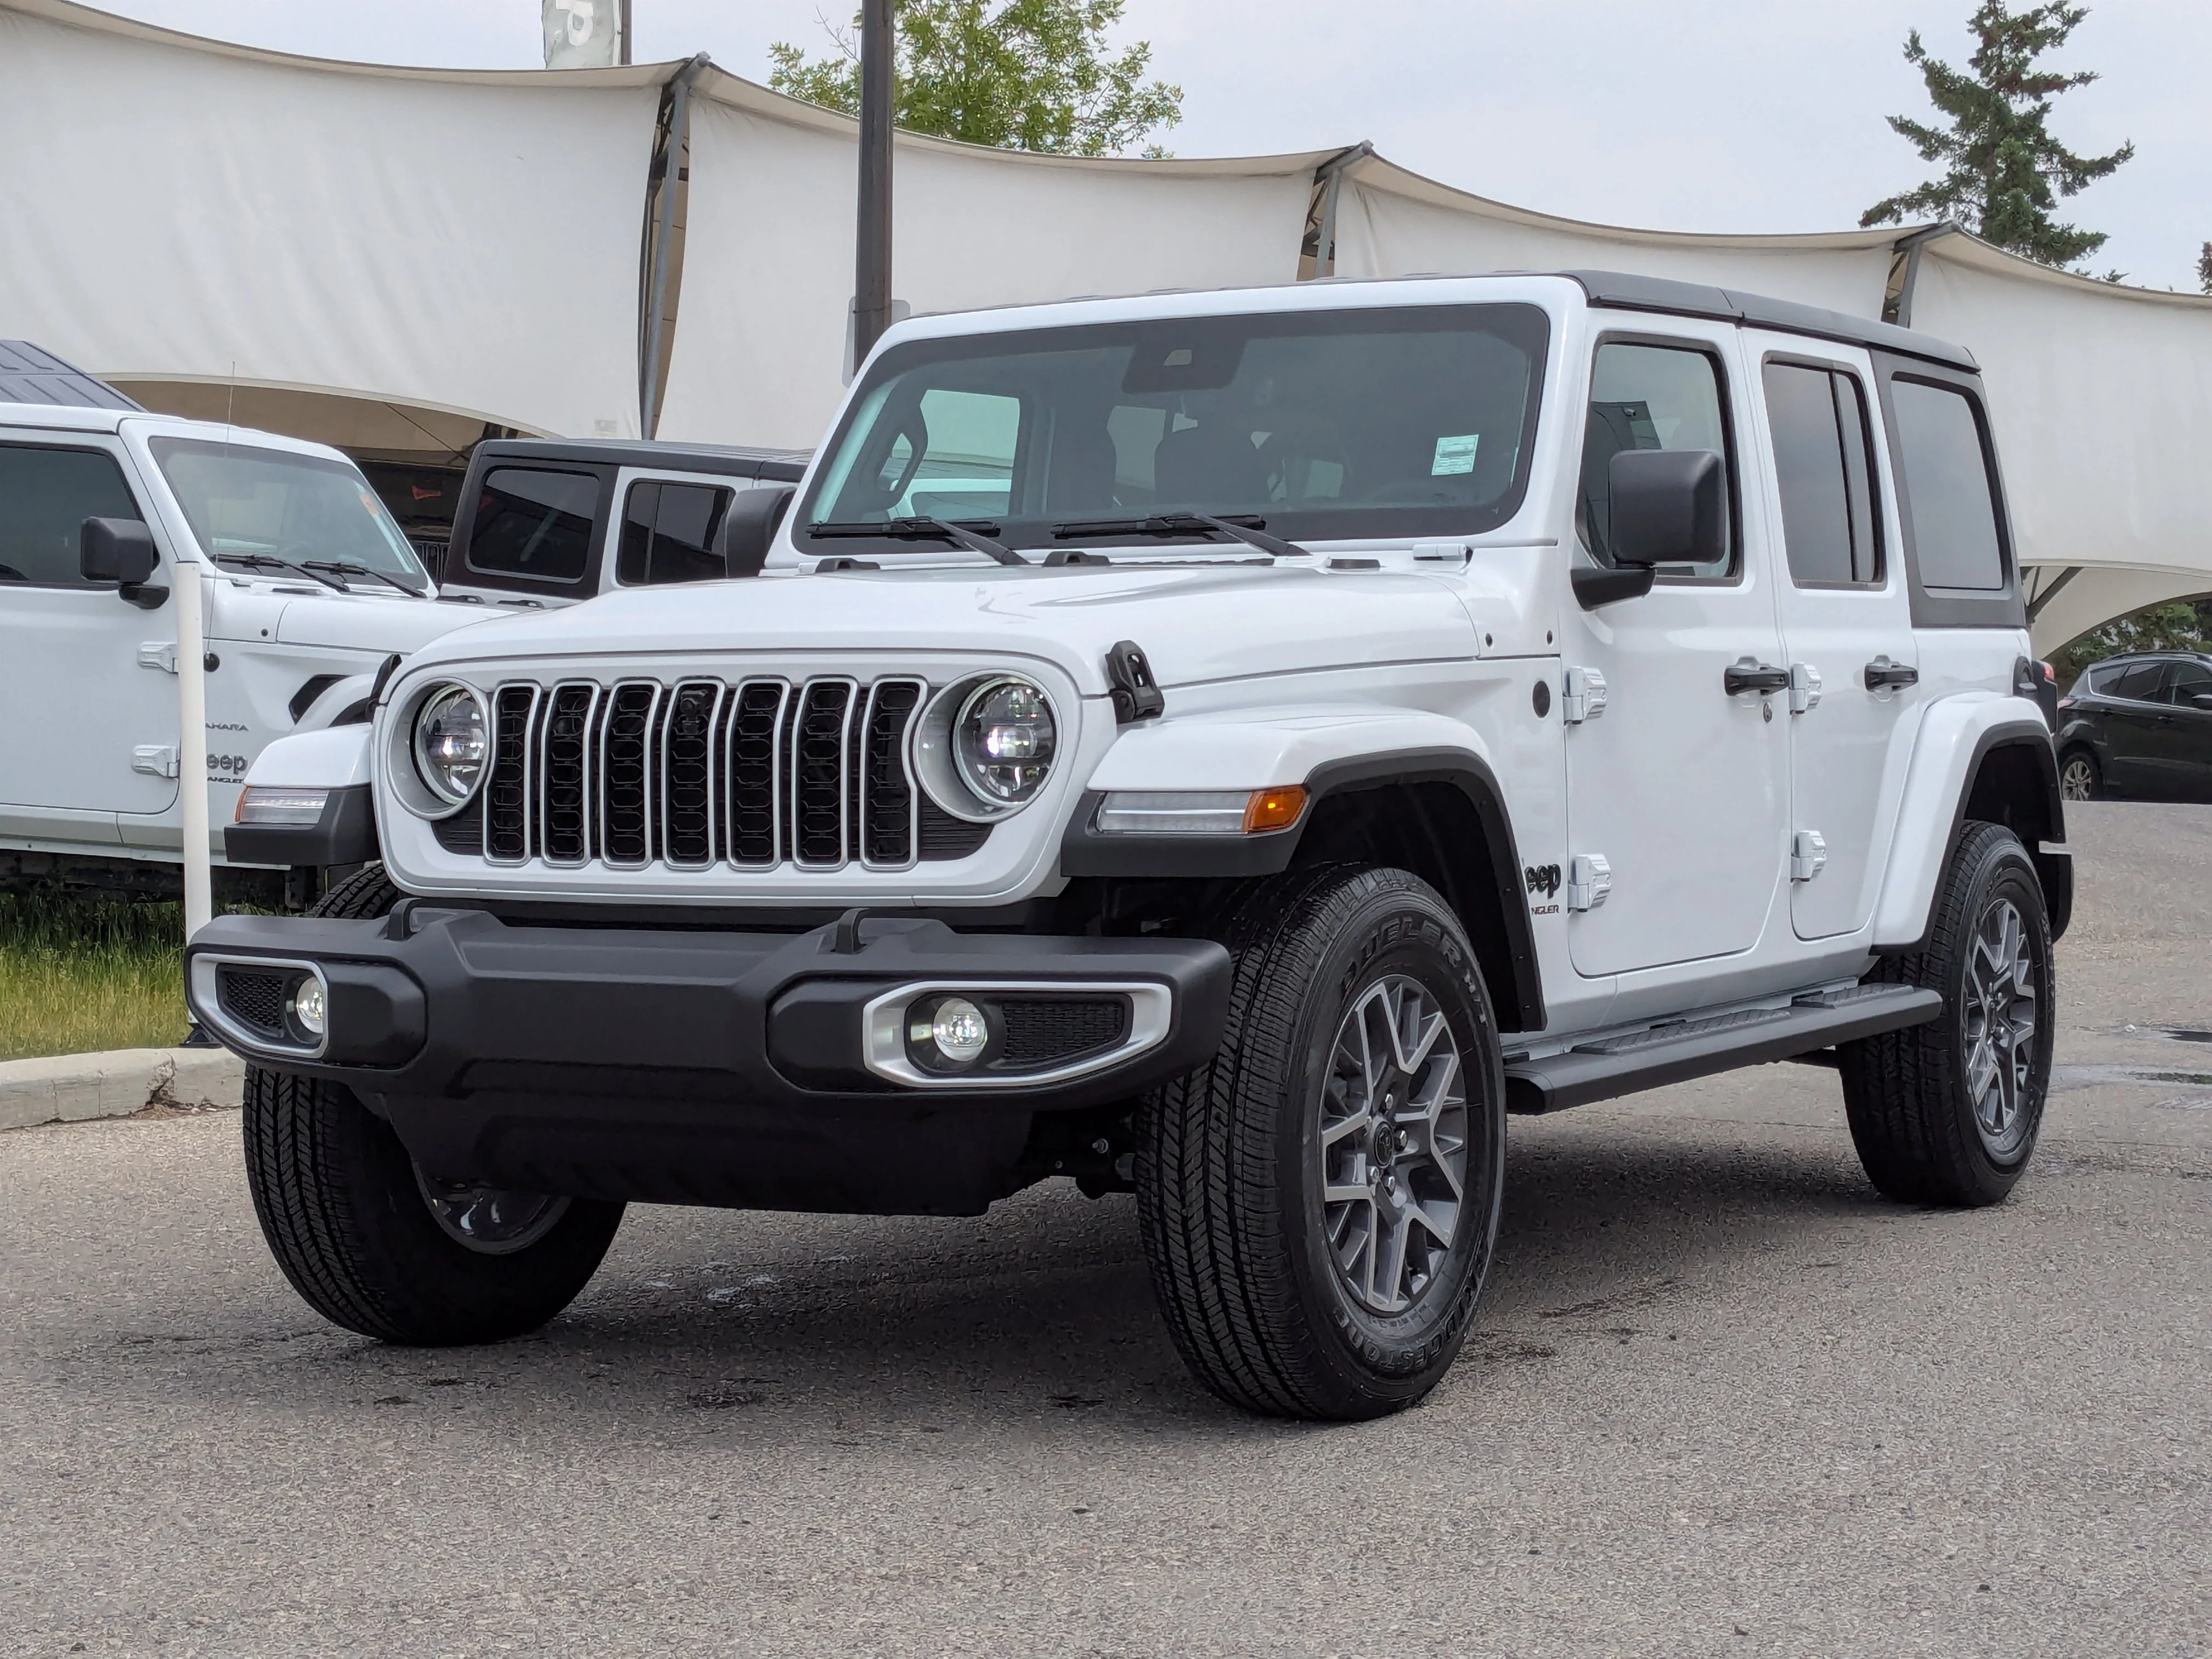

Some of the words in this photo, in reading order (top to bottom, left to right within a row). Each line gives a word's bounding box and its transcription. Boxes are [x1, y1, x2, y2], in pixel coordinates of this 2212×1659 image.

[205, 723, 249, 731] AHARA
[206, 754, 248, 775] eep
[1524, 864, 1561, 899] eep
[1532, 905, 1559, 915] NGLER
